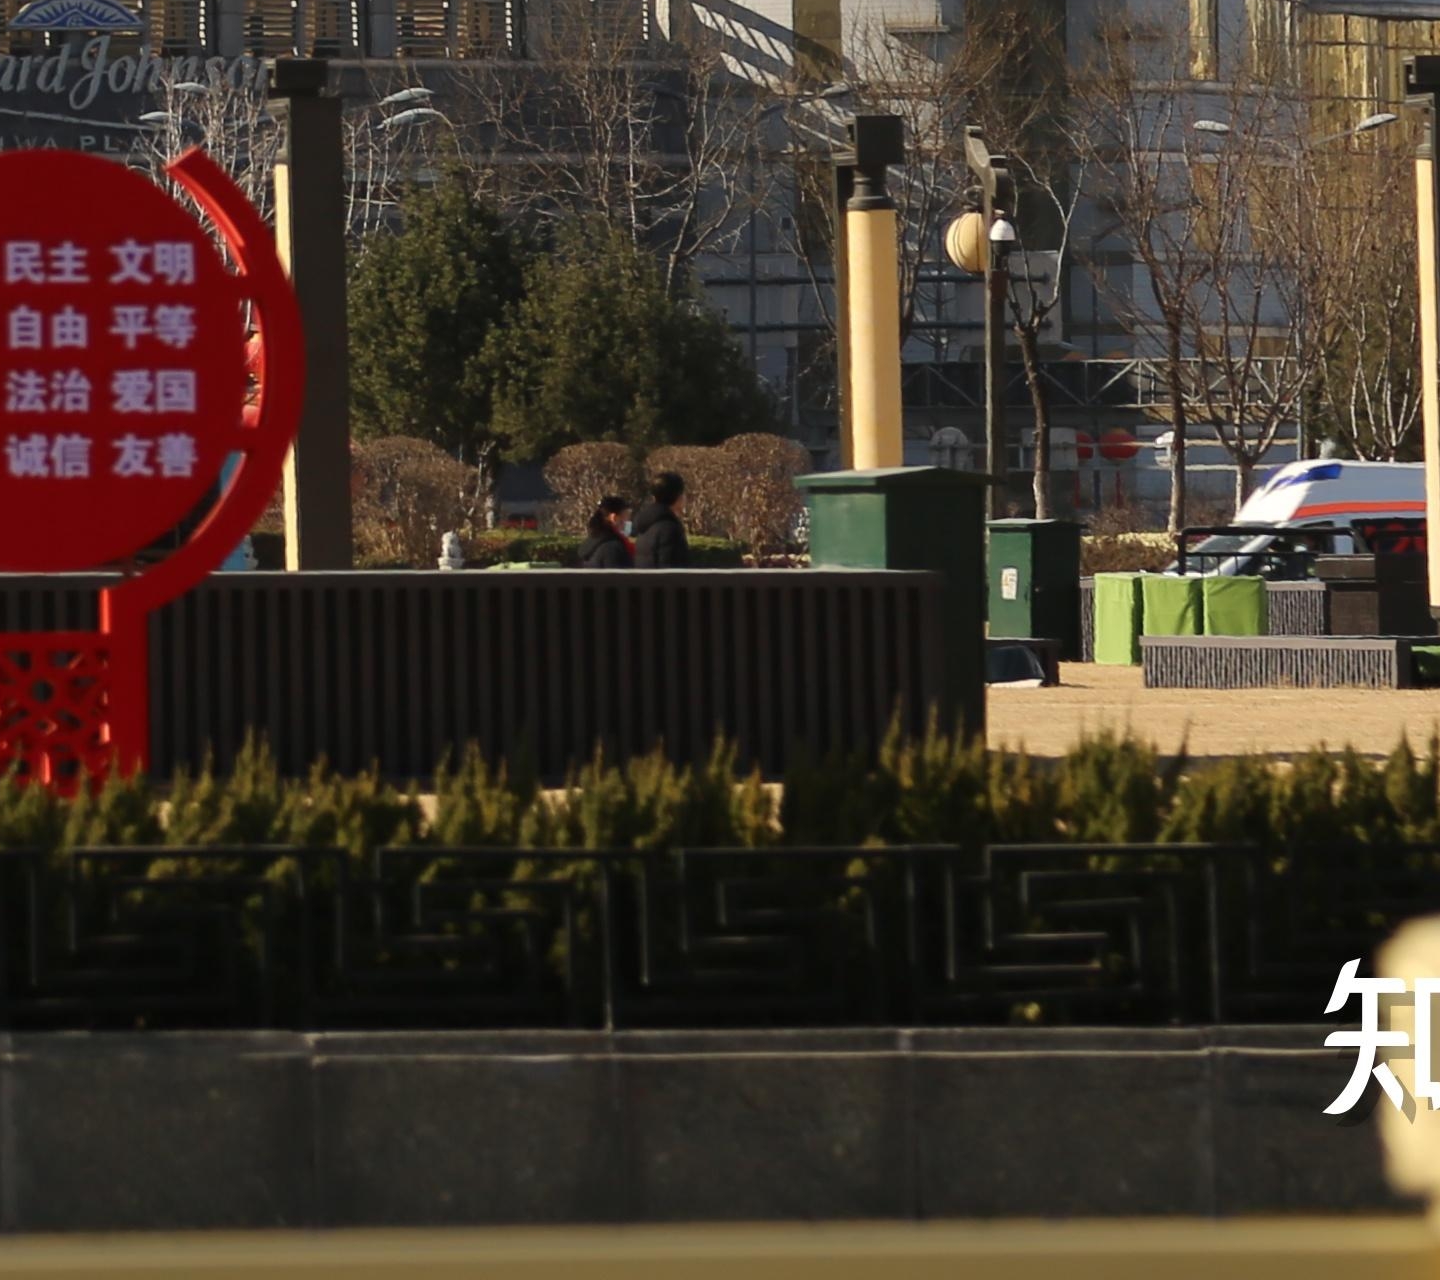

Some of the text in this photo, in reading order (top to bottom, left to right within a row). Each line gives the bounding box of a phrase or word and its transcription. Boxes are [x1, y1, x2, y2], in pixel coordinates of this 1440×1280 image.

[4, 241, 90, 284] 民主
[109, 239, 196, 285] 文明
[8, 304, 88, 348] 自由
[109, 305, 196, 348] 平等
[5, 369, 92, 412] 法治
[111, 370, 197, 412] 爱国
[5, 434, 93, 478] 诚信
[112, 433, 198, 478] 友善
